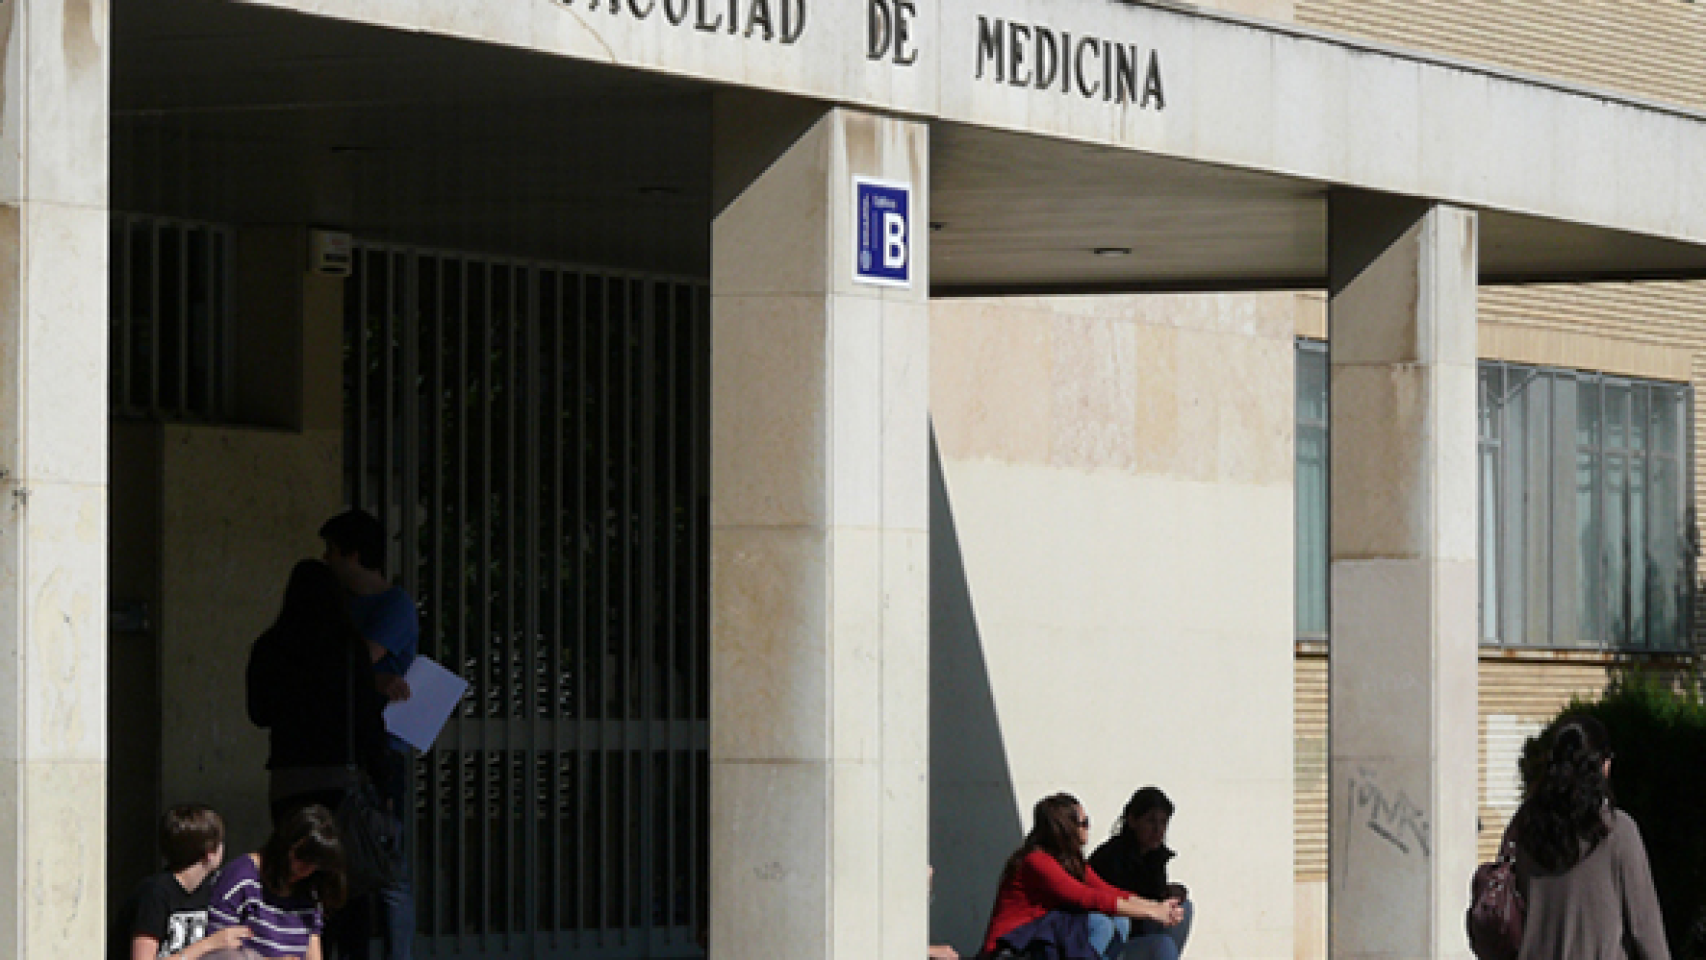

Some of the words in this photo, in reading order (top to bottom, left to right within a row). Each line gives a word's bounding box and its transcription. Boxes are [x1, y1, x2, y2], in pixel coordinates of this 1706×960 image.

[866, 0, 918, 66] DE
[974, 14, 1166, 111] MEDICINA
[882, 212, 906, 269] B
